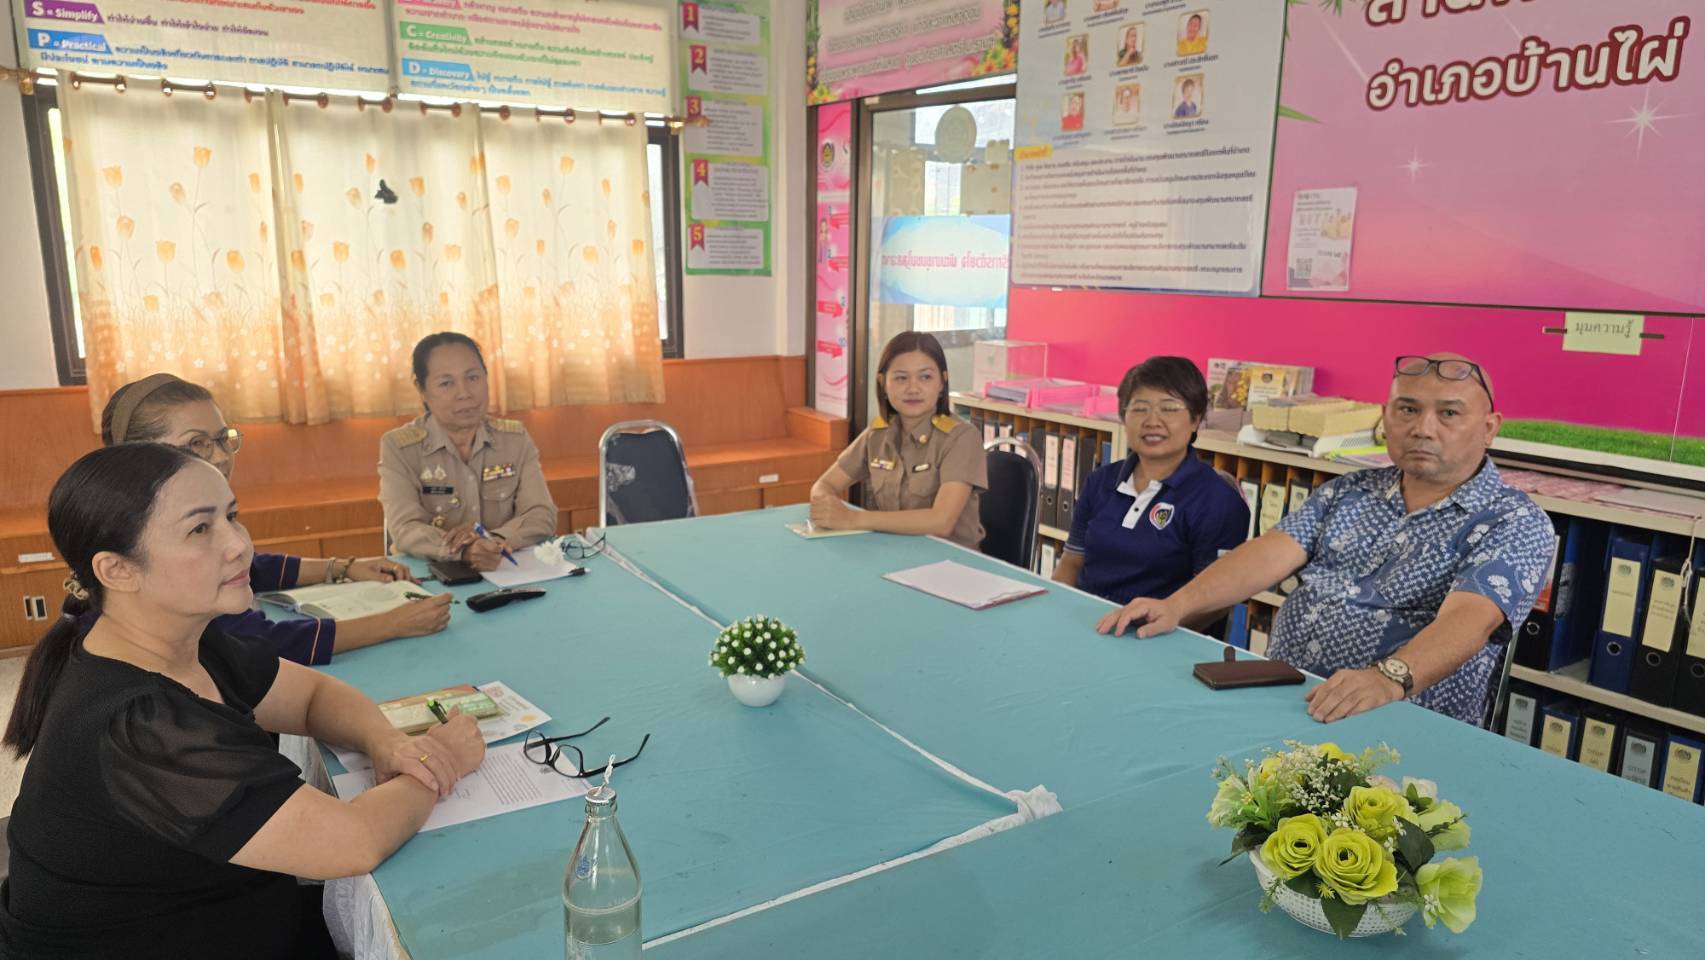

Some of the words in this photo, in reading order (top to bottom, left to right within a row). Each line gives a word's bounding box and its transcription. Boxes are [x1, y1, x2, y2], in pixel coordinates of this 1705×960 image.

[32, 2, 45, 17] S
[55, 8, 99, 23] Simplify
[687, 5, 694, 21] 1
[406, 24, 416, 37] C
[38, 32, 50, 48] P
[695, 48, 704, 64] 2
[1367, 17, 1690, 110] อำเภอบ้านไผ่
[408, 62, 420, 74] D
[429, 67, 469, 79] Discovery
[689, 98, 698, 114] 3
[697, 161, 706, 177] 4
[693, 226, 702, 241] 5
[1575, 319, 1635, 339] มุมความรู้
